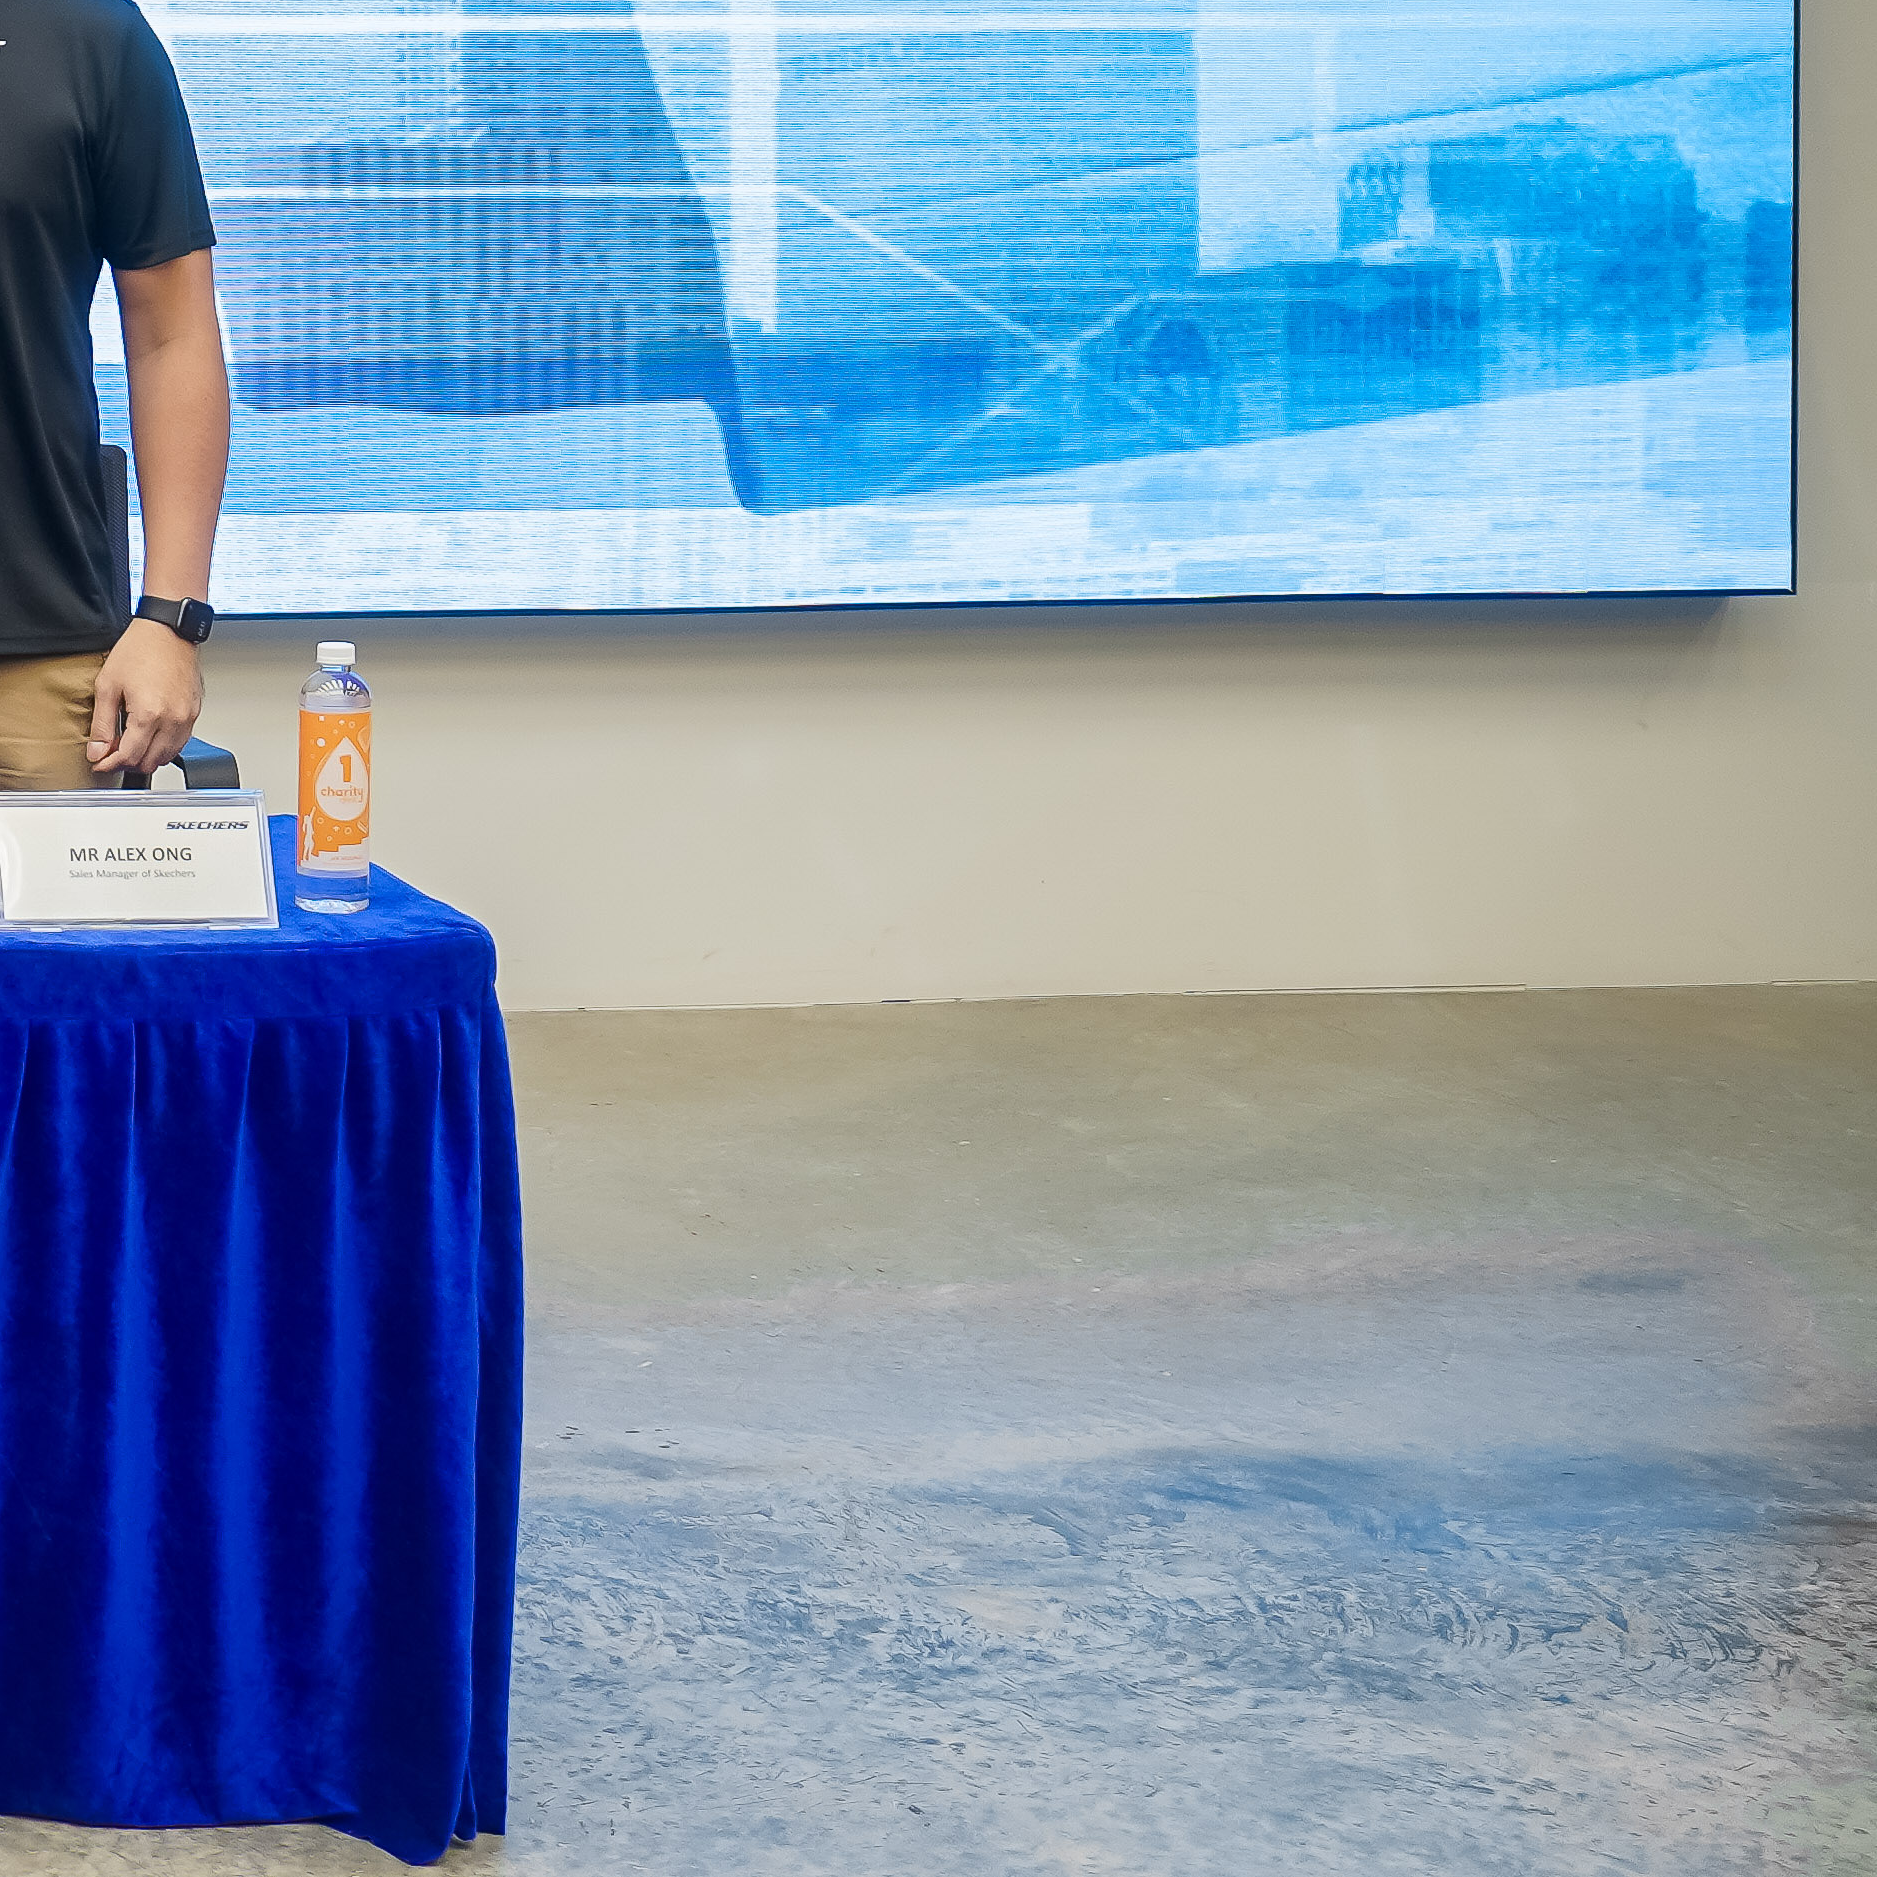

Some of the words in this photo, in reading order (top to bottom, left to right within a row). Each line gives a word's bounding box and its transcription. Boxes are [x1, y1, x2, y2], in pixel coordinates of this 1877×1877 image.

[339, 754, 351, 782] 1
[320, 785, 364, 803] charity
[166, 821, 250, 830] SKECHERS
[69, 847, 100, 862] MR
[104, 847, 148, 862] ALEX
[152, 847, 193, 862] ONG
[69, 869, 94, 879] Sales
[96, 869, 138, 880] Manager
[141, 868, 152, 878] of
[153, 868, 196, 878] Skechers
